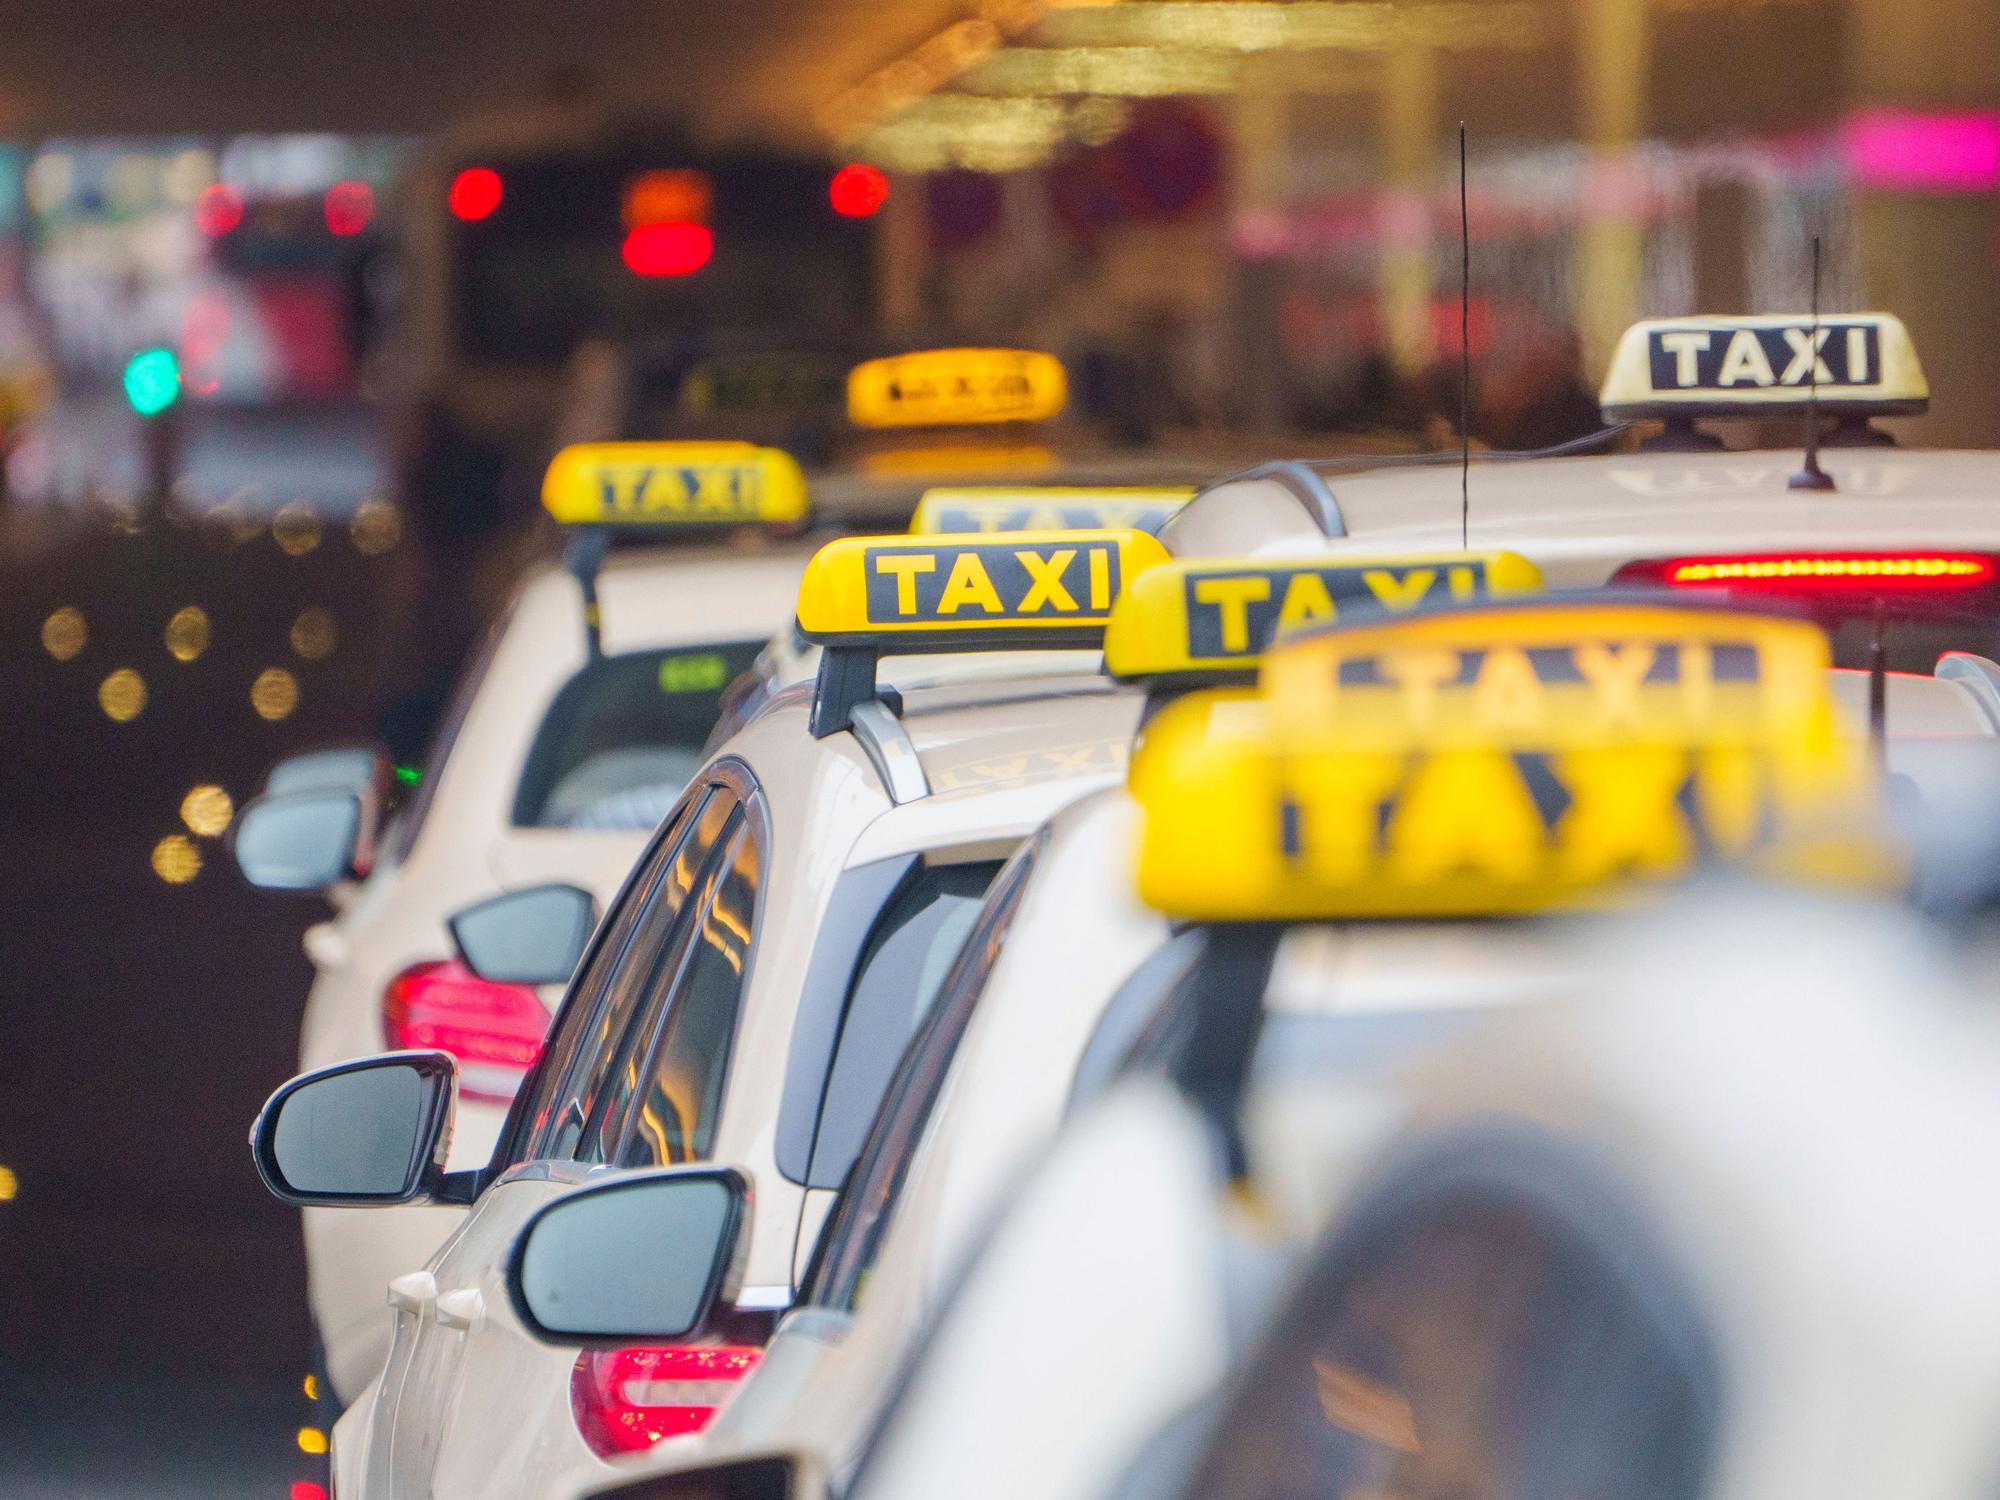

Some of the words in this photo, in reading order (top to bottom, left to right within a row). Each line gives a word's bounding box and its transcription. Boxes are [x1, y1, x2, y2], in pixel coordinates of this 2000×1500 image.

[1661, 327, 1868, 387] TAXI
[604, 463, 758, 513] TAXI
[876, 549, 1110, 616] TAXI
